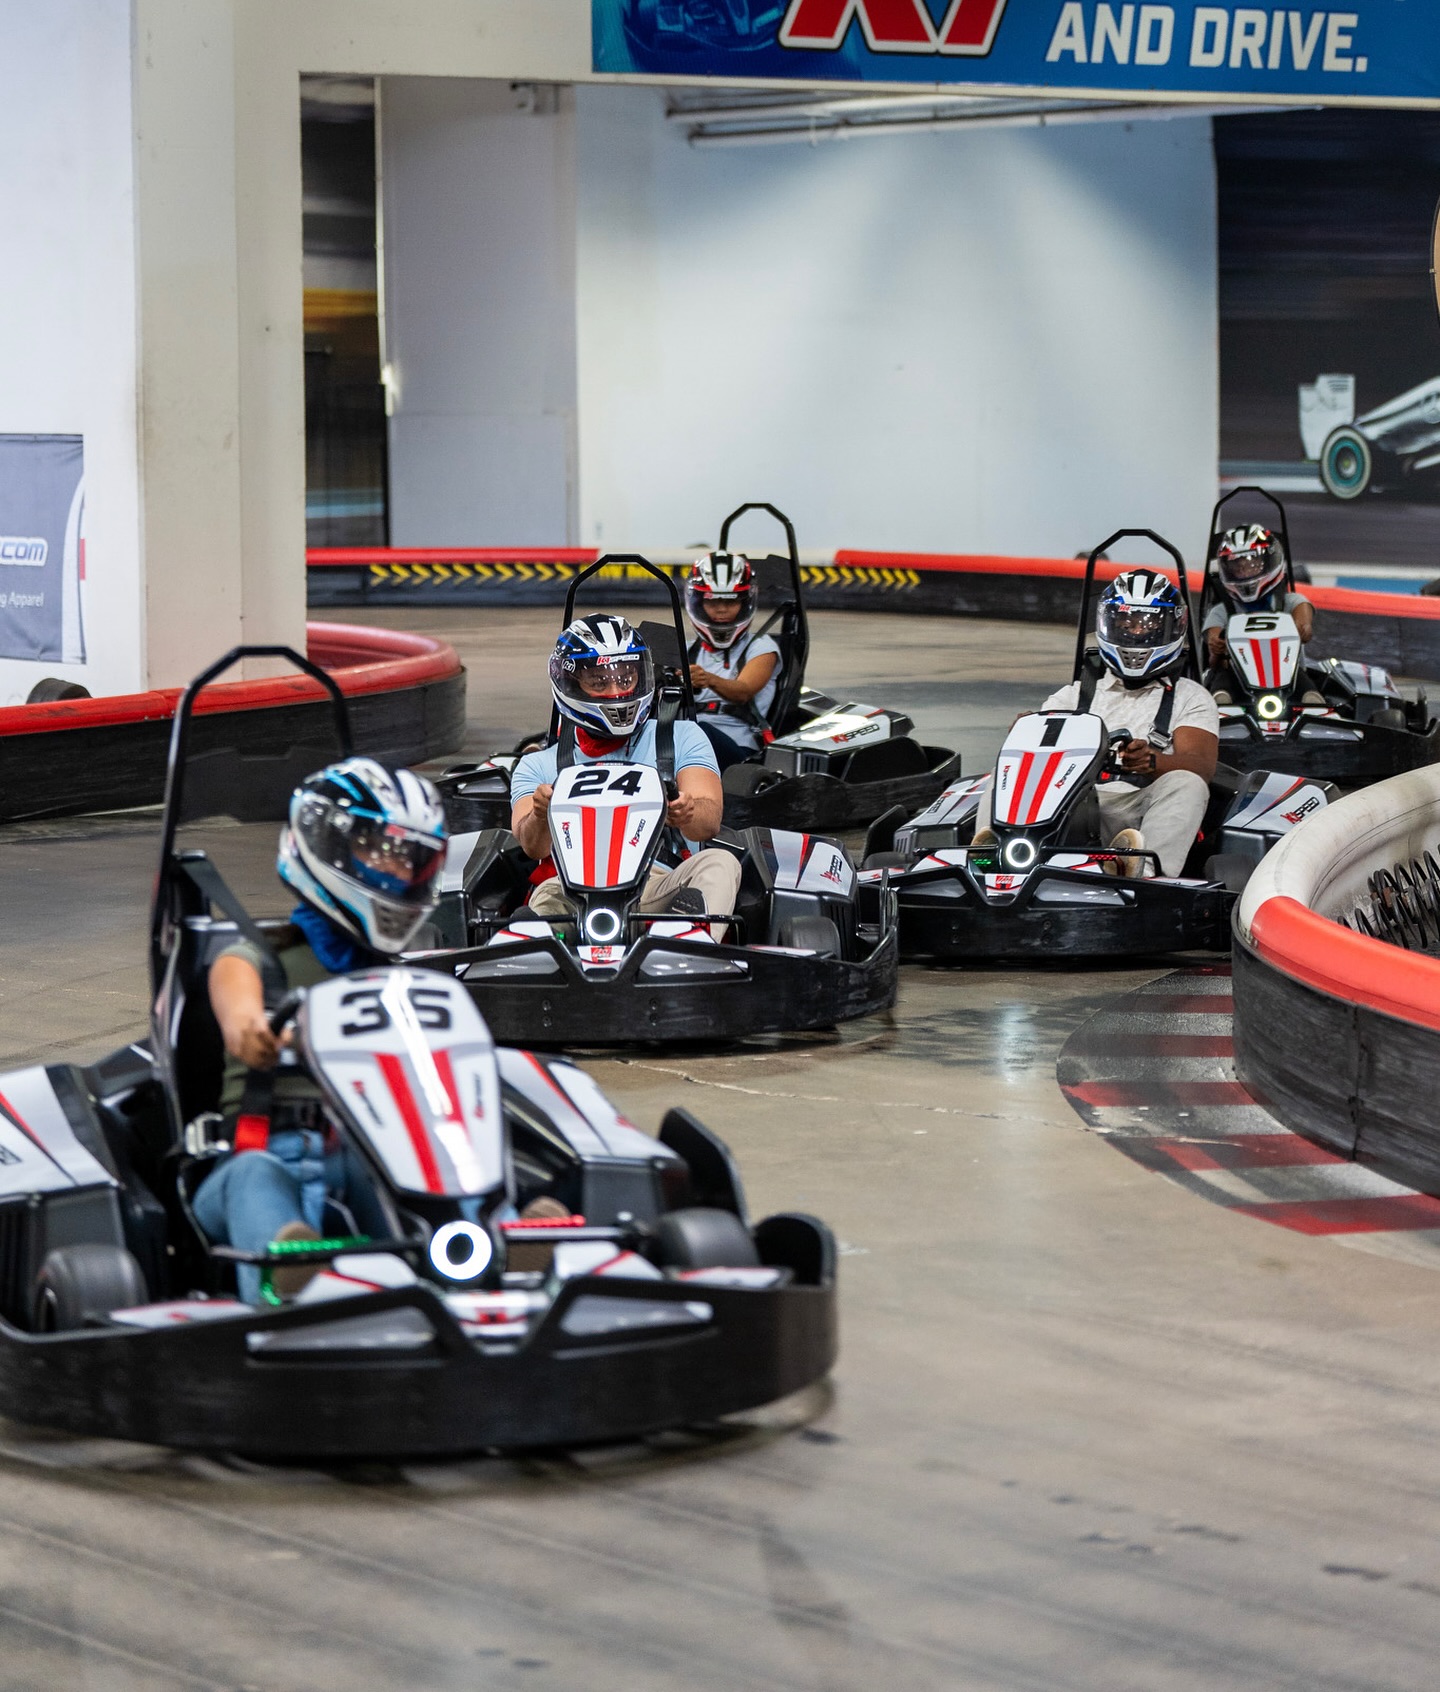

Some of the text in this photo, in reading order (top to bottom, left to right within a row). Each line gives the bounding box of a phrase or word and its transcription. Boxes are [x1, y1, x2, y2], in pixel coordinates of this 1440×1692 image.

[1045, 2, 1175, 65] AND
[1189, 7, 1368, 72] DRIVE.
[1244, 616, 1280, 632] 5
[1038, 718, 1067, 747] 1
[567, 769, 643, 799] 24
[340, 988, 451, 1037] 35
